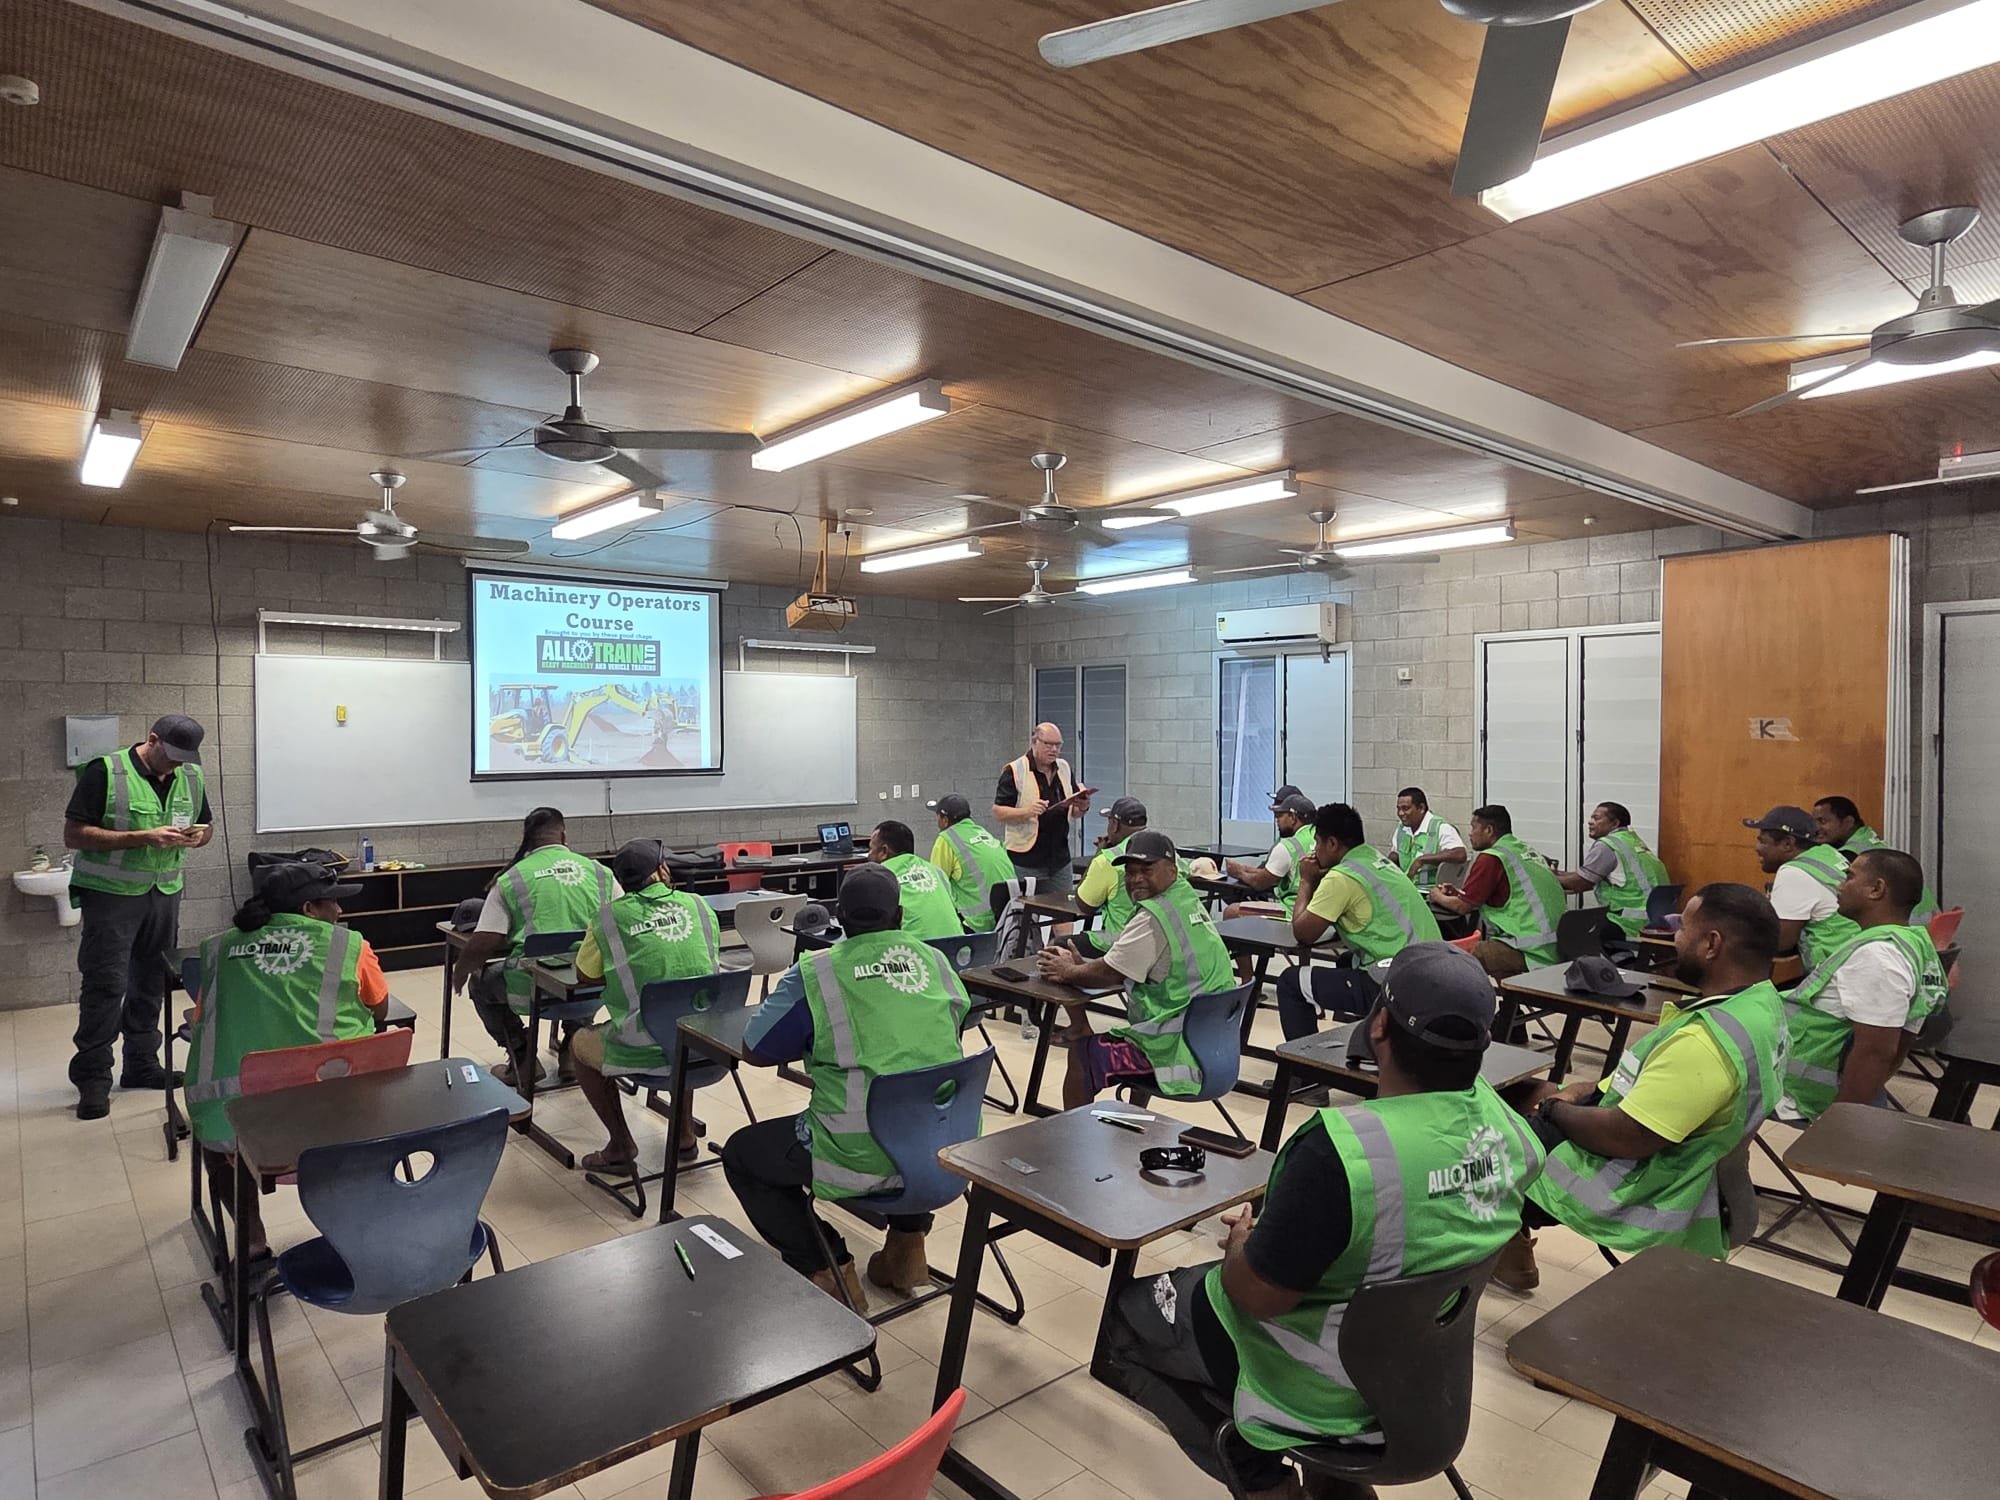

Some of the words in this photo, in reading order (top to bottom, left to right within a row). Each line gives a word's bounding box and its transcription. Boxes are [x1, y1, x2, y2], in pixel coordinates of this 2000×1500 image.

[489, 583, 601, 609] Machinery
[607, 592, 701, 612] Operators
[566, 613, 634, 631] Course
[1760, 719, 1775, 739] K
